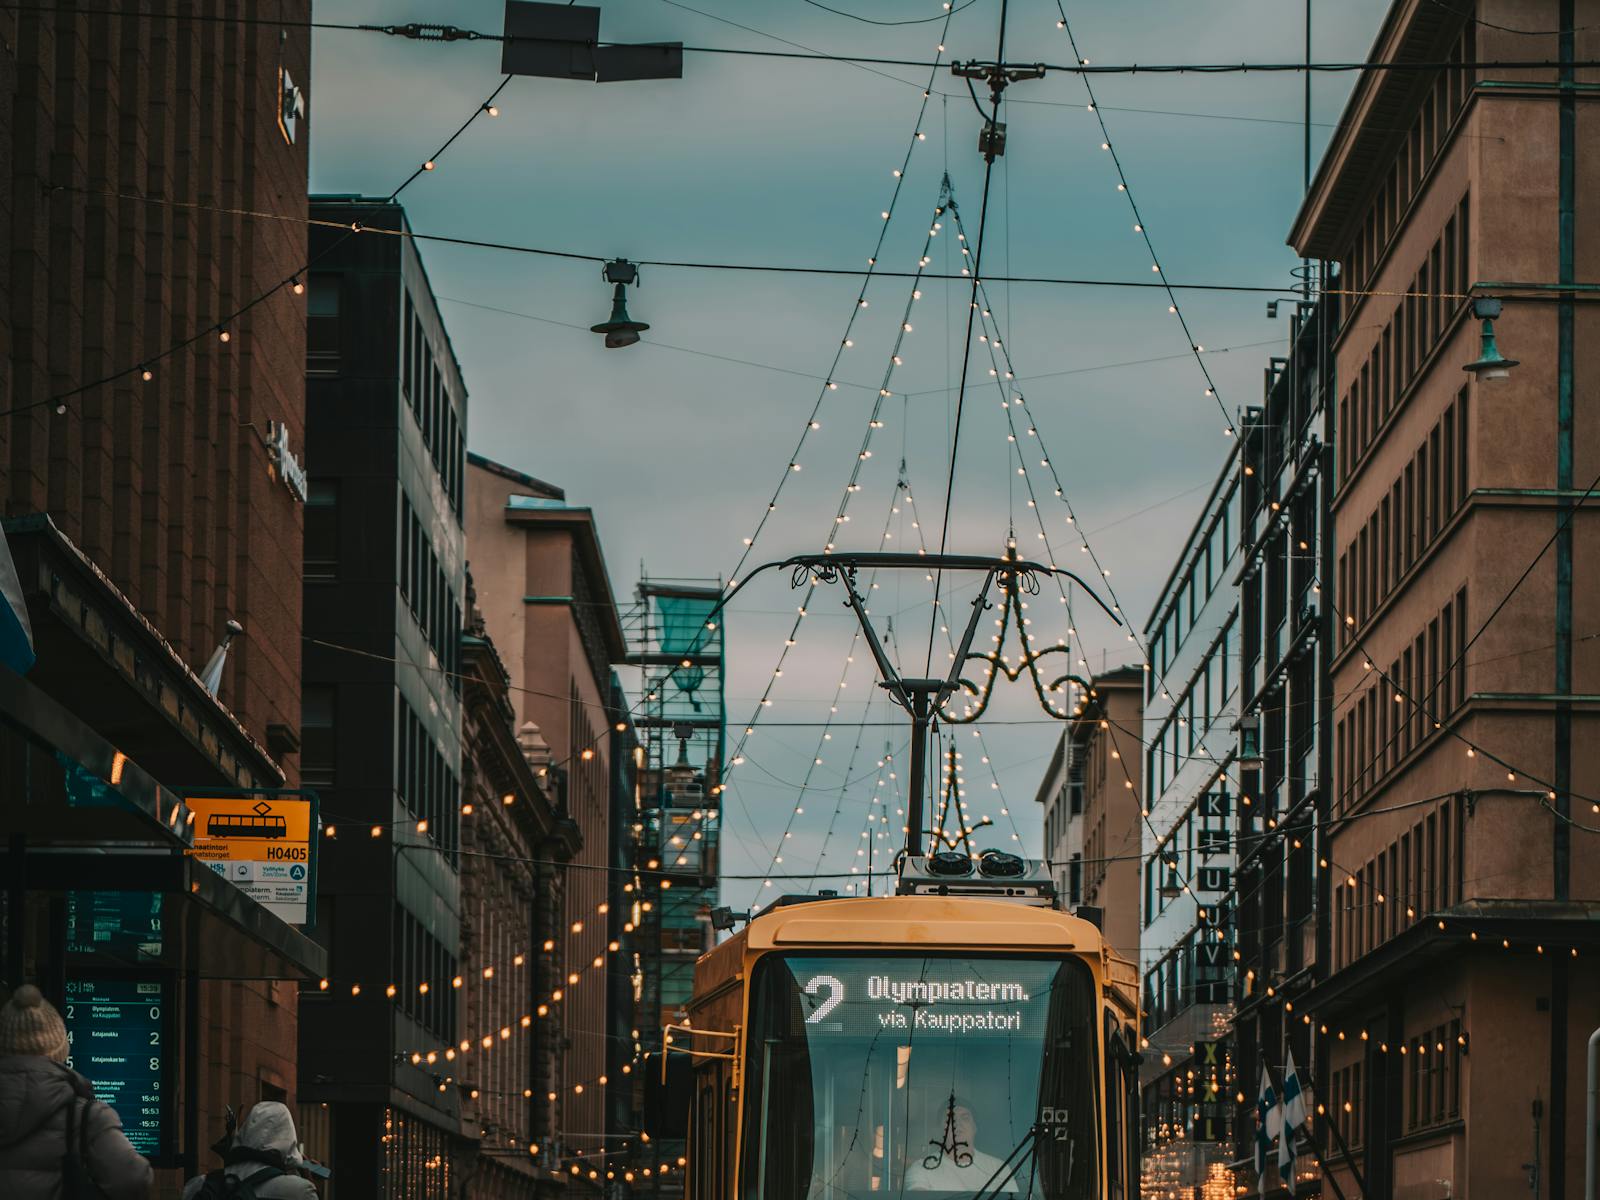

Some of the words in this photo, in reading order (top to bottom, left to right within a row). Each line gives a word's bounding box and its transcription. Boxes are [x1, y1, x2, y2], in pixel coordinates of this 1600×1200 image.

[267, 848, 306, 860] H0405
[293, 866, 303, 878] A
[1205, 794, 1222, 1002] KLUUVI
[805, 975, 844, 1023] 2
[868, 976, 1029, 1004] Olympiaterm.
[67, 1005, 75, 1019] 2
[150, 1006, 160, 1019] 0
[879, 1011, 907, 1028] via
[915, 1011, 1021, 1032] Kauppatori
[67, 1031, 74, 1045] 4
[150, 1032, 160, 1045] 2
[66, 1056, 74, 1070] 5
[150, 1057, 160, 1071] 8
[153, 1082, 160, 1091] 9
[1203, 1042, 1218, 1140] XXL
